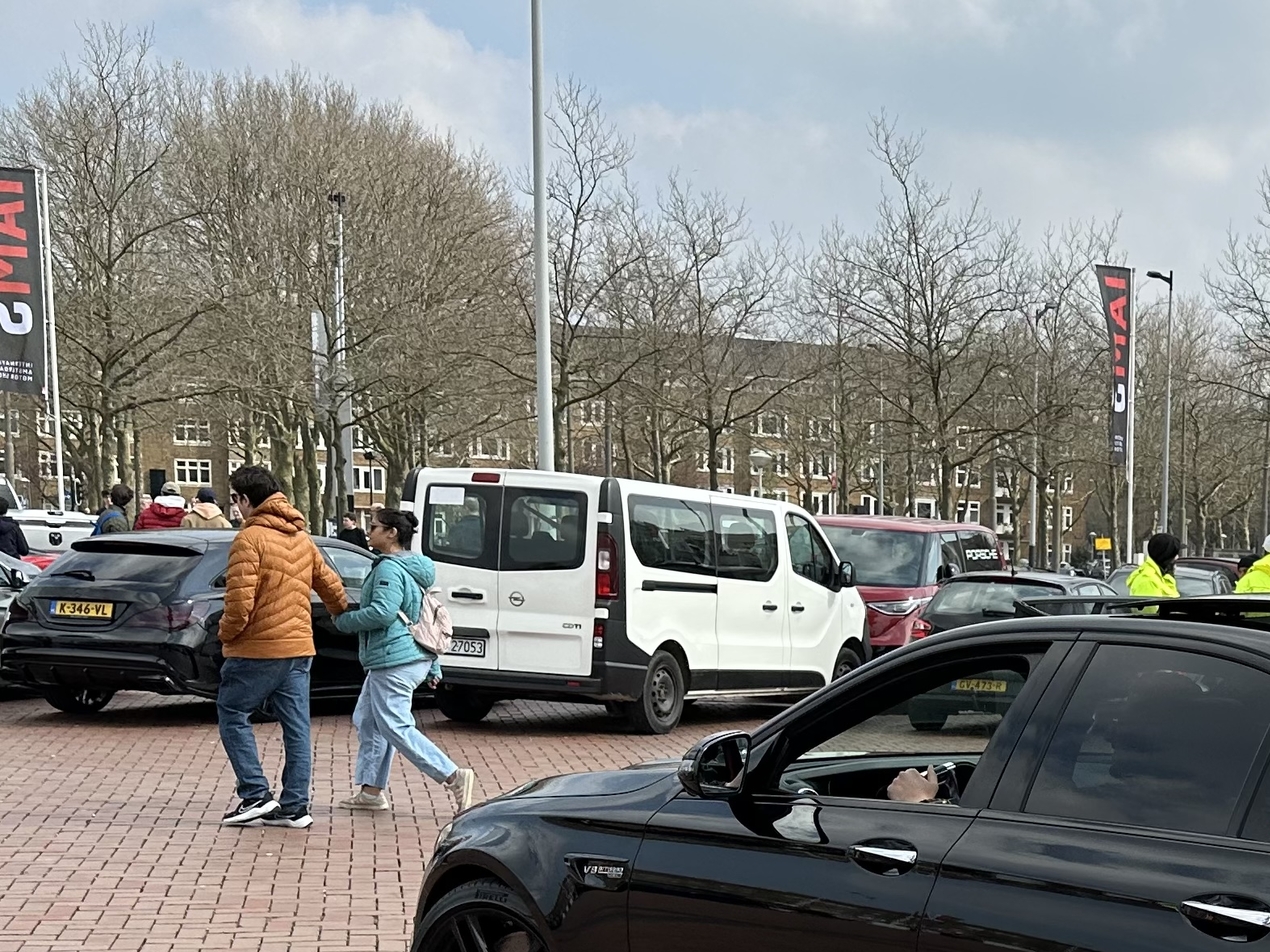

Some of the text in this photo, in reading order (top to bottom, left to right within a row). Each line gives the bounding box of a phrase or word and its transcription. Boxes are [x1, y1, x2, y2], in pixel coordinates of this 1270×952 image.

[966, 549, 998, 560] PORSCHE
[59, 602, 108, 616] K-346-VL
[450, 640, 483, 654] 27053
[959, 680, 1003, 690] GV-473-R
[583, 865, 598, 874] V8
